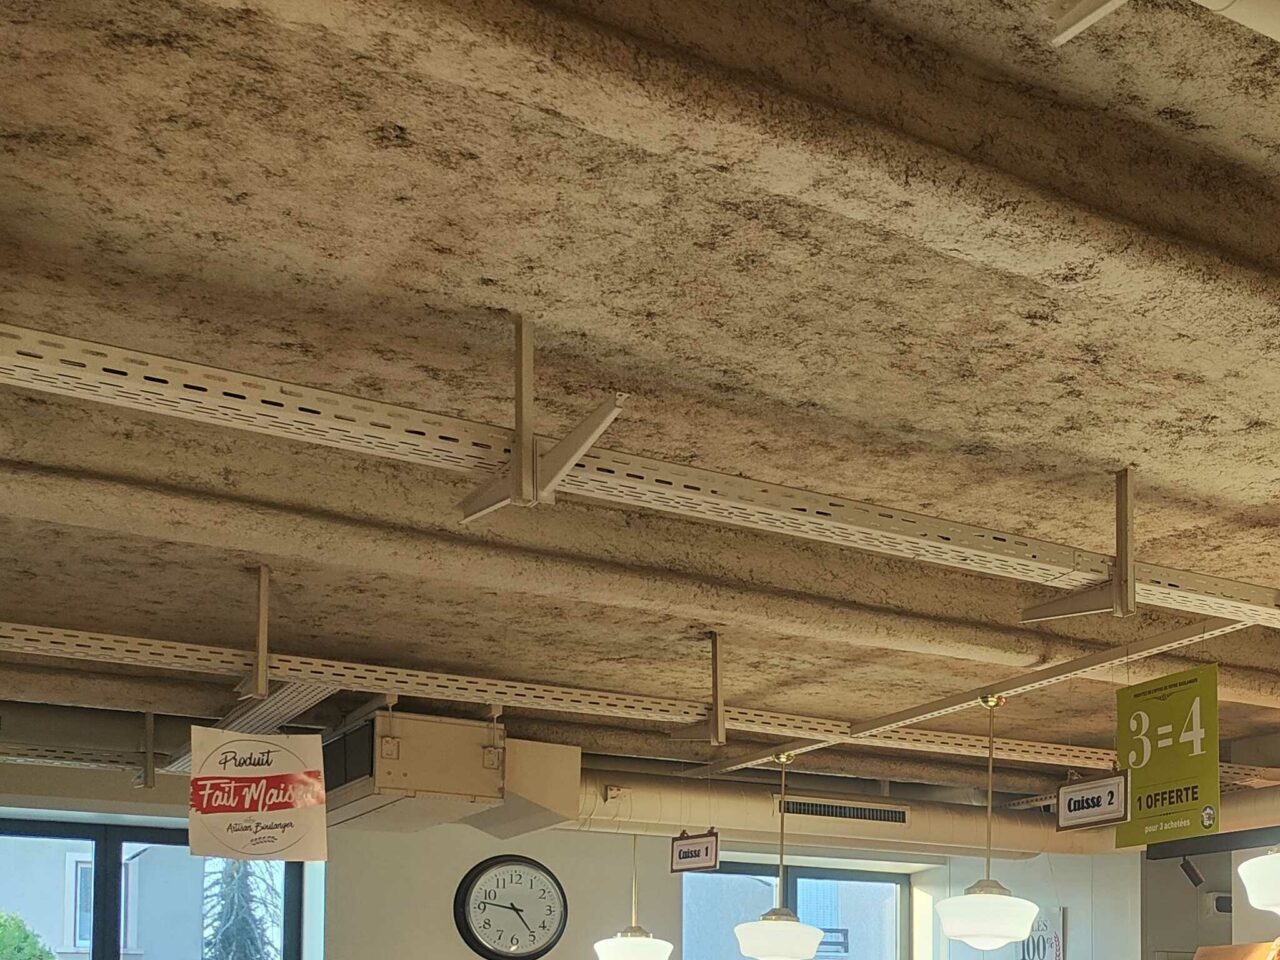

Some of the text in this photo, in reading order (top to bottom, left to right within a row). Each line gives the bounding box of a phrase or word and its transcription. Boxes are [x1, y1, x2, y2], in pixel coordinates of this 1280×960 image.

[218, 749, 281, 770] Produit
[197, 779, 312, 812] Fait Mais
[1067, 790, 1115, 813] Caisse 2
[1136, 785, 1199, 811] 1 OFFERTE
[226, 821, 294, 834] Artisan Boulanger
[1145, 824, 1158, 835] pour
[678, 846, 709, 860] Caisse 1
[496, 878, 506, 889] 11
[509, 873, 522, 884] 12
[530, 878, 534, 889] 1
[484, 889, 497, 900] 10
[538, 888, 546, 900] 2
[477, 901, 486, 914] 9
[545, 905, 552, 916] 3
[482, 918, 491, 929] 8
[538, 919, 547, 930] 4
[496, 929, 504, 940] 7
[510, 933, 519, 945] 6
[528, 930, 536, 942] 5
